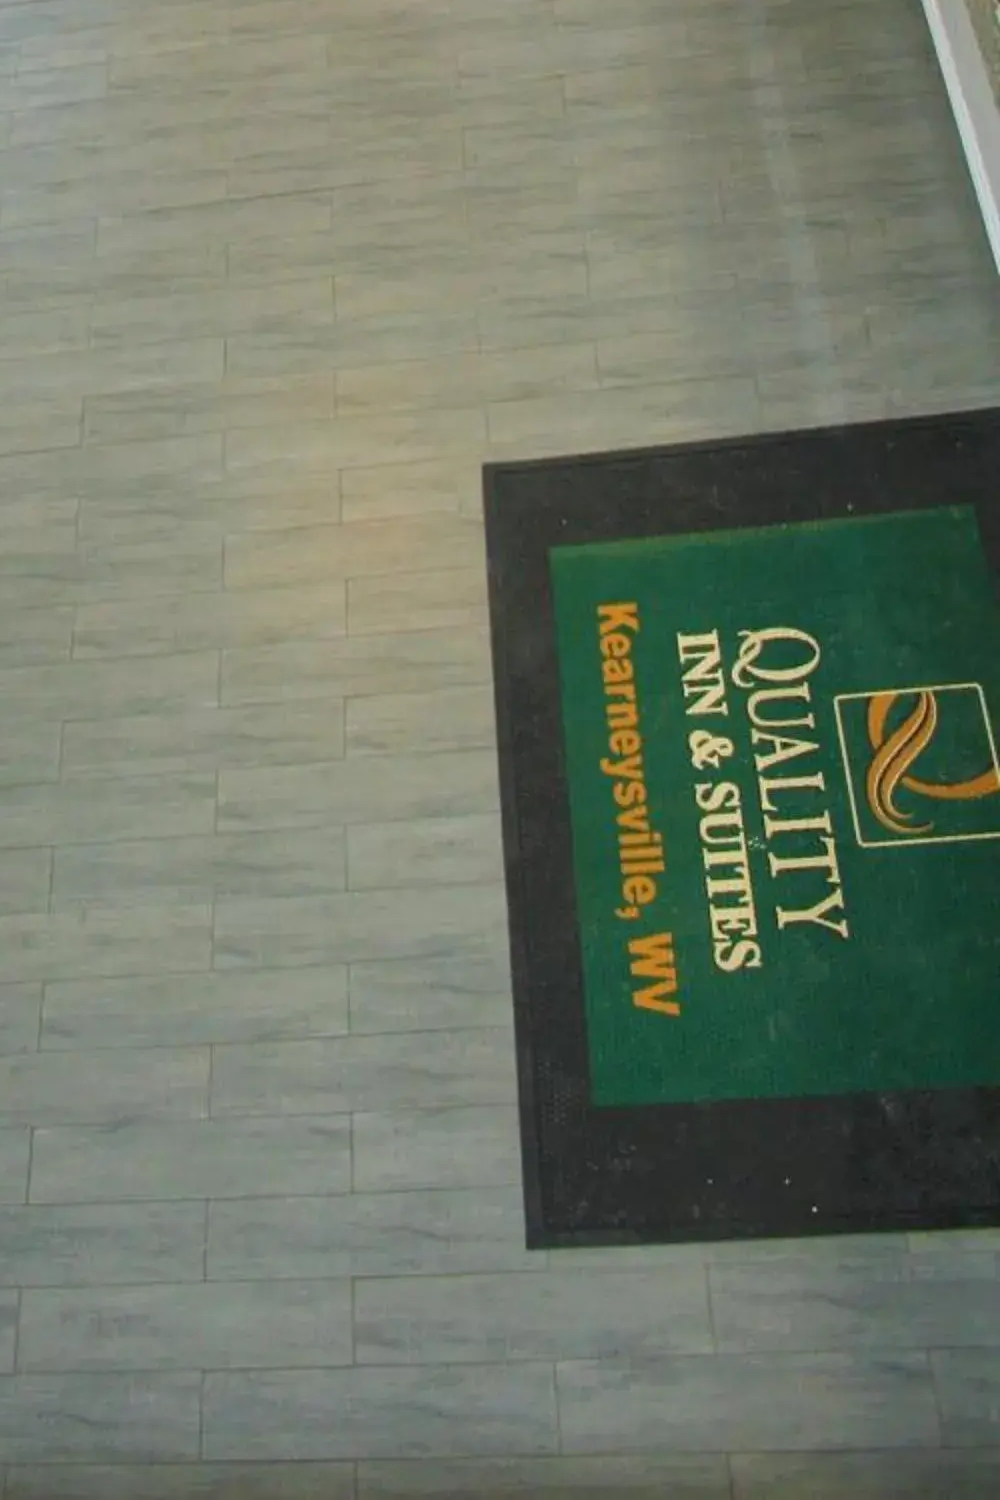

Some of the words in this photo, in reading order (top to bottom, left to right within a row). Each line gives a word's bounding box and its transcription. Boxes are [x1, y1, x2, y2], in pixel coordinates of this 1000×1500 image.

[676, 627, 729, 717] INN
[597, 601, 665, 920] Kearneysville,
[688, 729, 735, 771] &
[730, 627, 849, 939] QUALITY
[694, 781, 763, 973] SUITES
[627, 931, 681, 1016] WV
